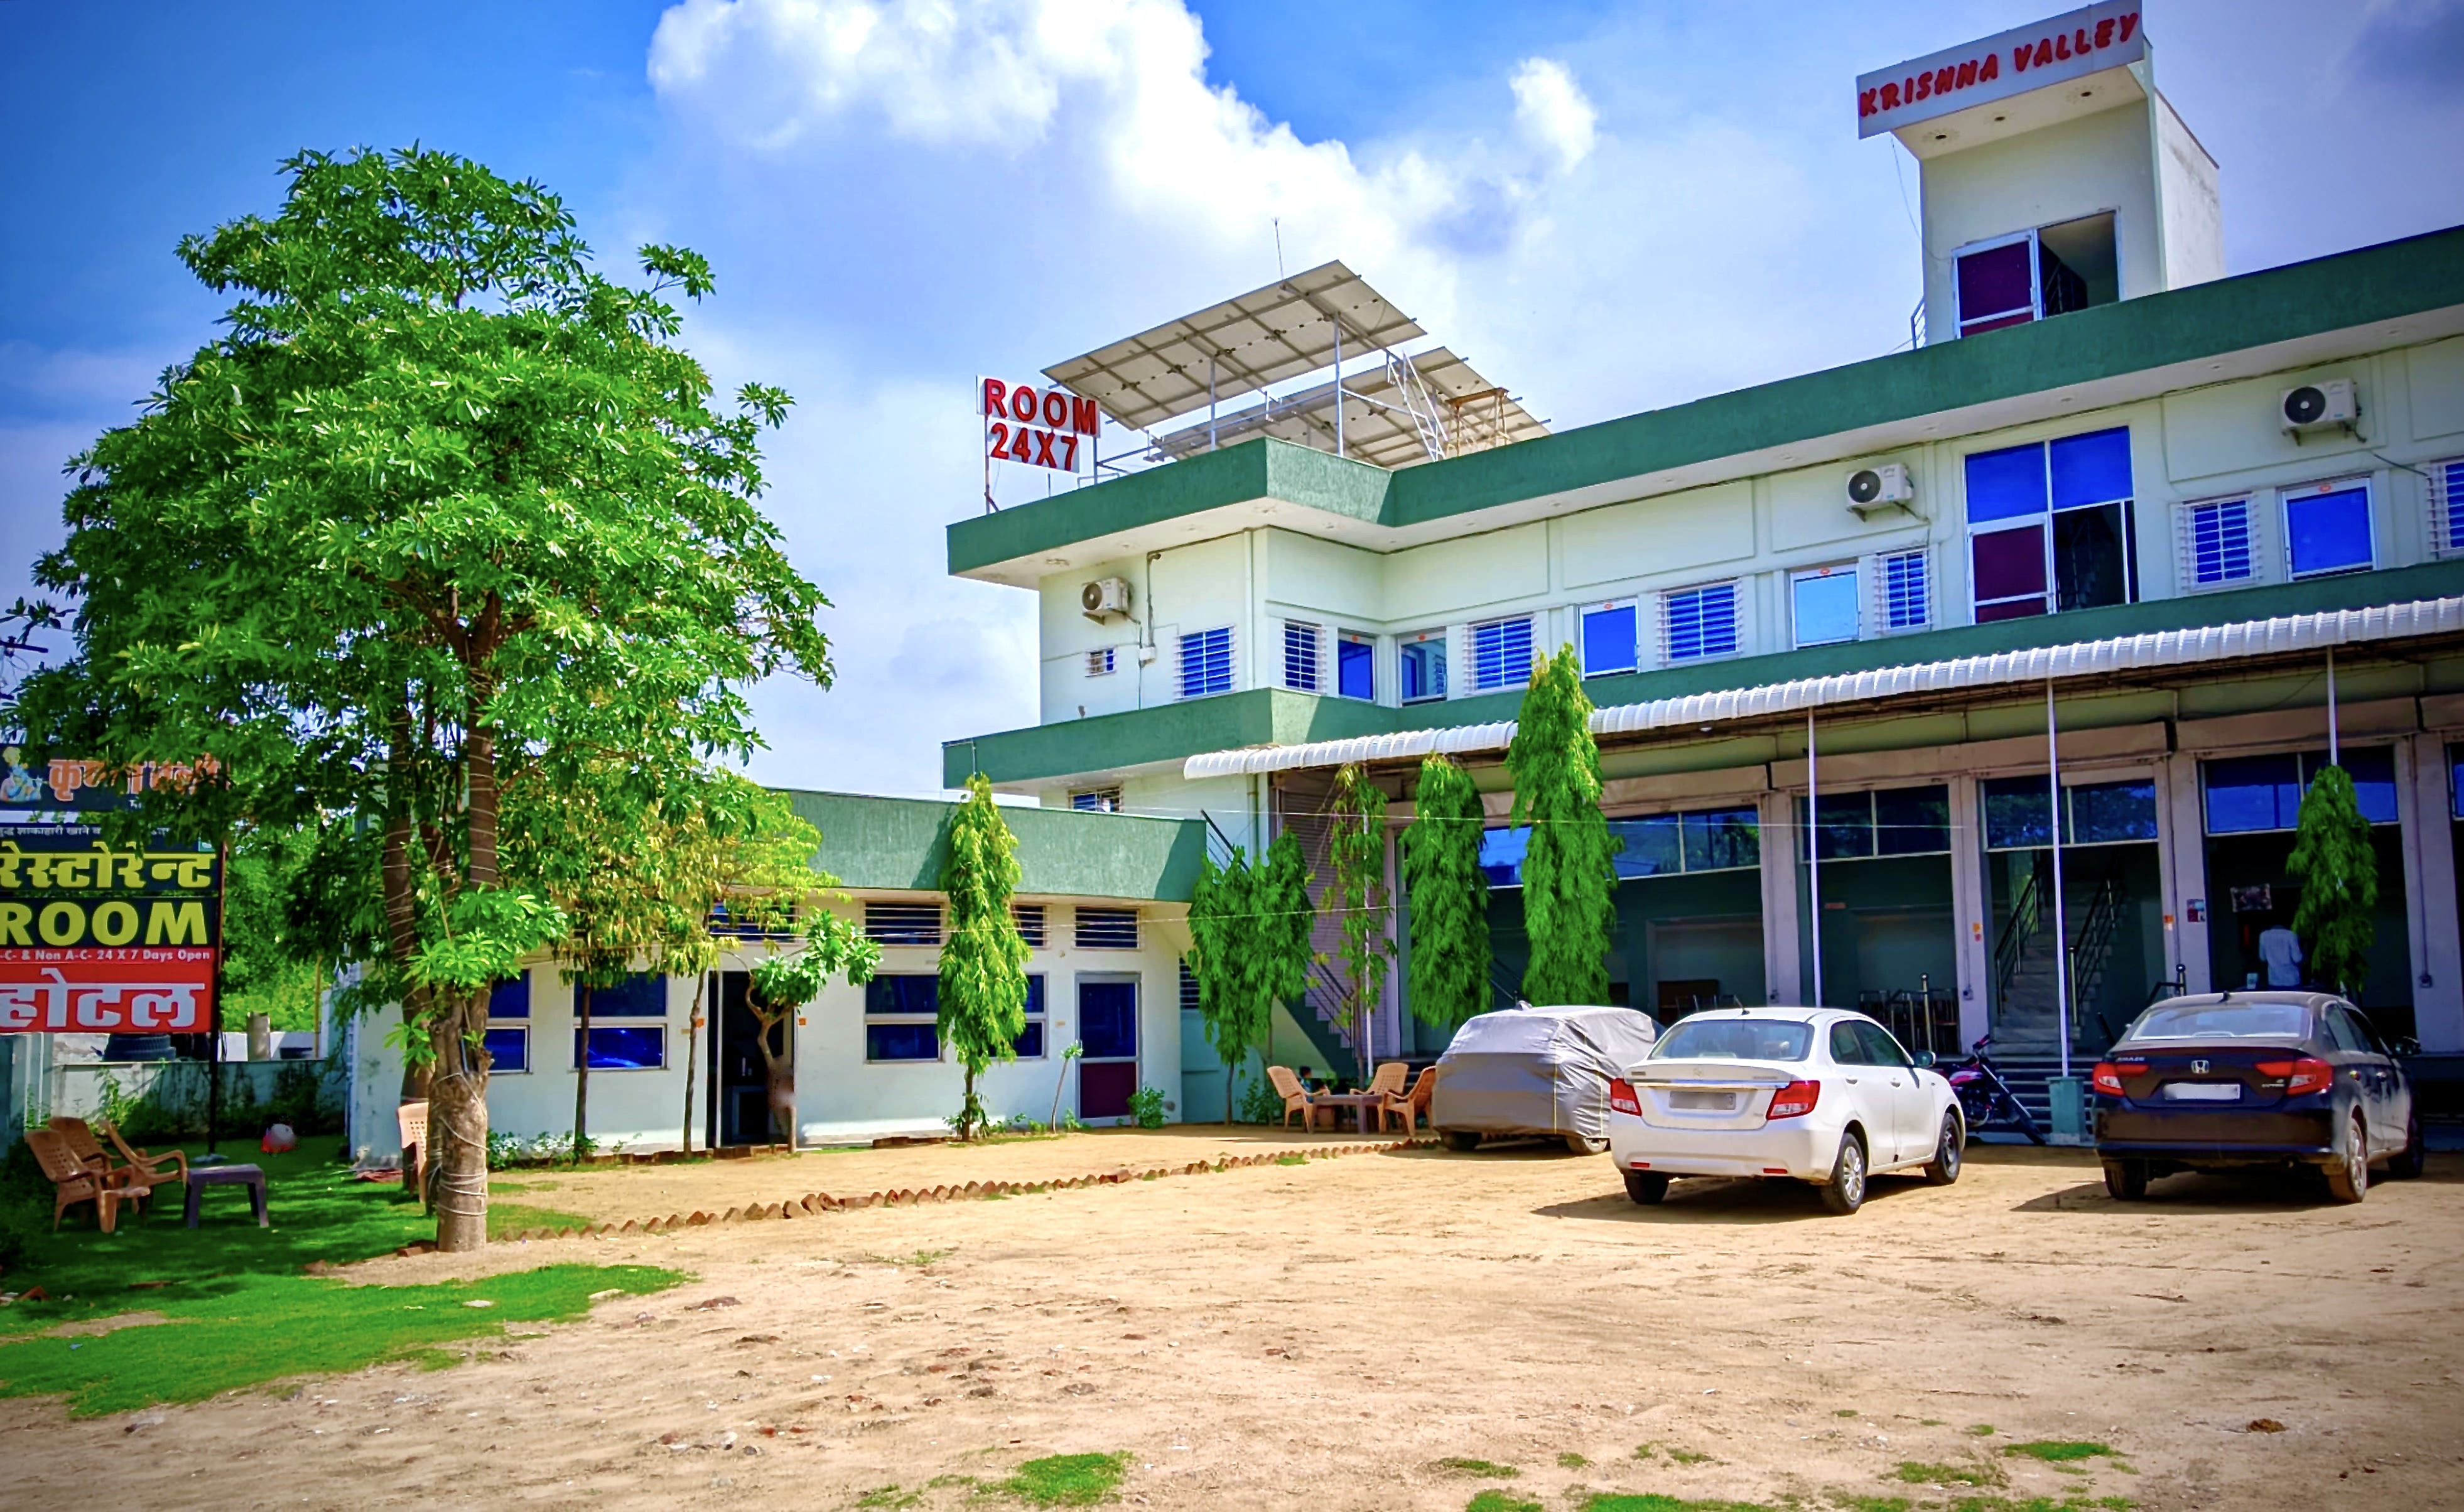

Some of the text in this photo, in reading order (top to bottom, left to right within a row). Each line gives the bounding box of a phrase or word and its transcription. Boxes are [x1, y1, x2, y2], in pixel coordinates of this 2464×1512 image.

[1859, 12, 2139, 117] KRISHNA VALLEY
[984, 378, 1096, 435] ROOM
[990, 422, 1078, 472] 24X7
[0, 902, 207, 946] ROOM
[21, 949, 31, 960] &
[35, 949, 61, 960] Non
[97, 949, 112, 960] 24
[143, 949, 173, 963] Days
[178, 949, 210, 963] Open
[0, 968, 205, 1027] होटल
